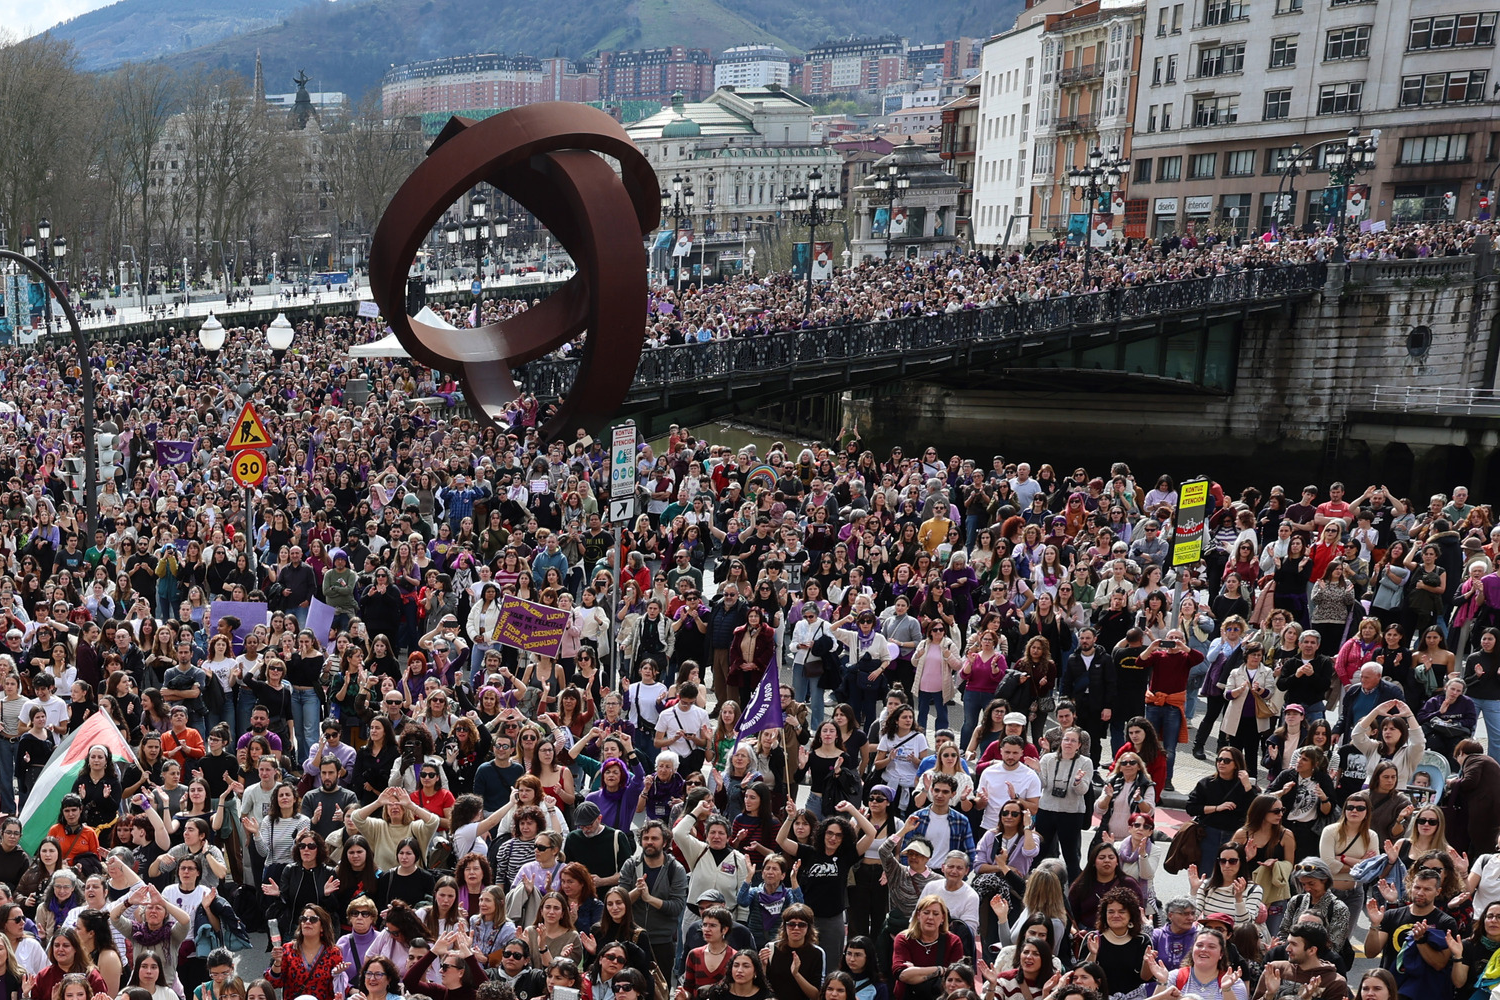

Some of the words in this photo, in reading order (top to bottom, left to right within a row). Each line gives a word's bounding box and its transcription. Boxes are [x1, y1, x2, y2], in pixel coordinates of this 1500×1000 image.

[1158, 201, 1175, 211] diseño
[1187, 198, 1209, 211] interior
[615, 429, 633, 437] KONTUZ
[239, 466, 260, 478] 30
[1185, 485, 1203, 493] KONTUZ
